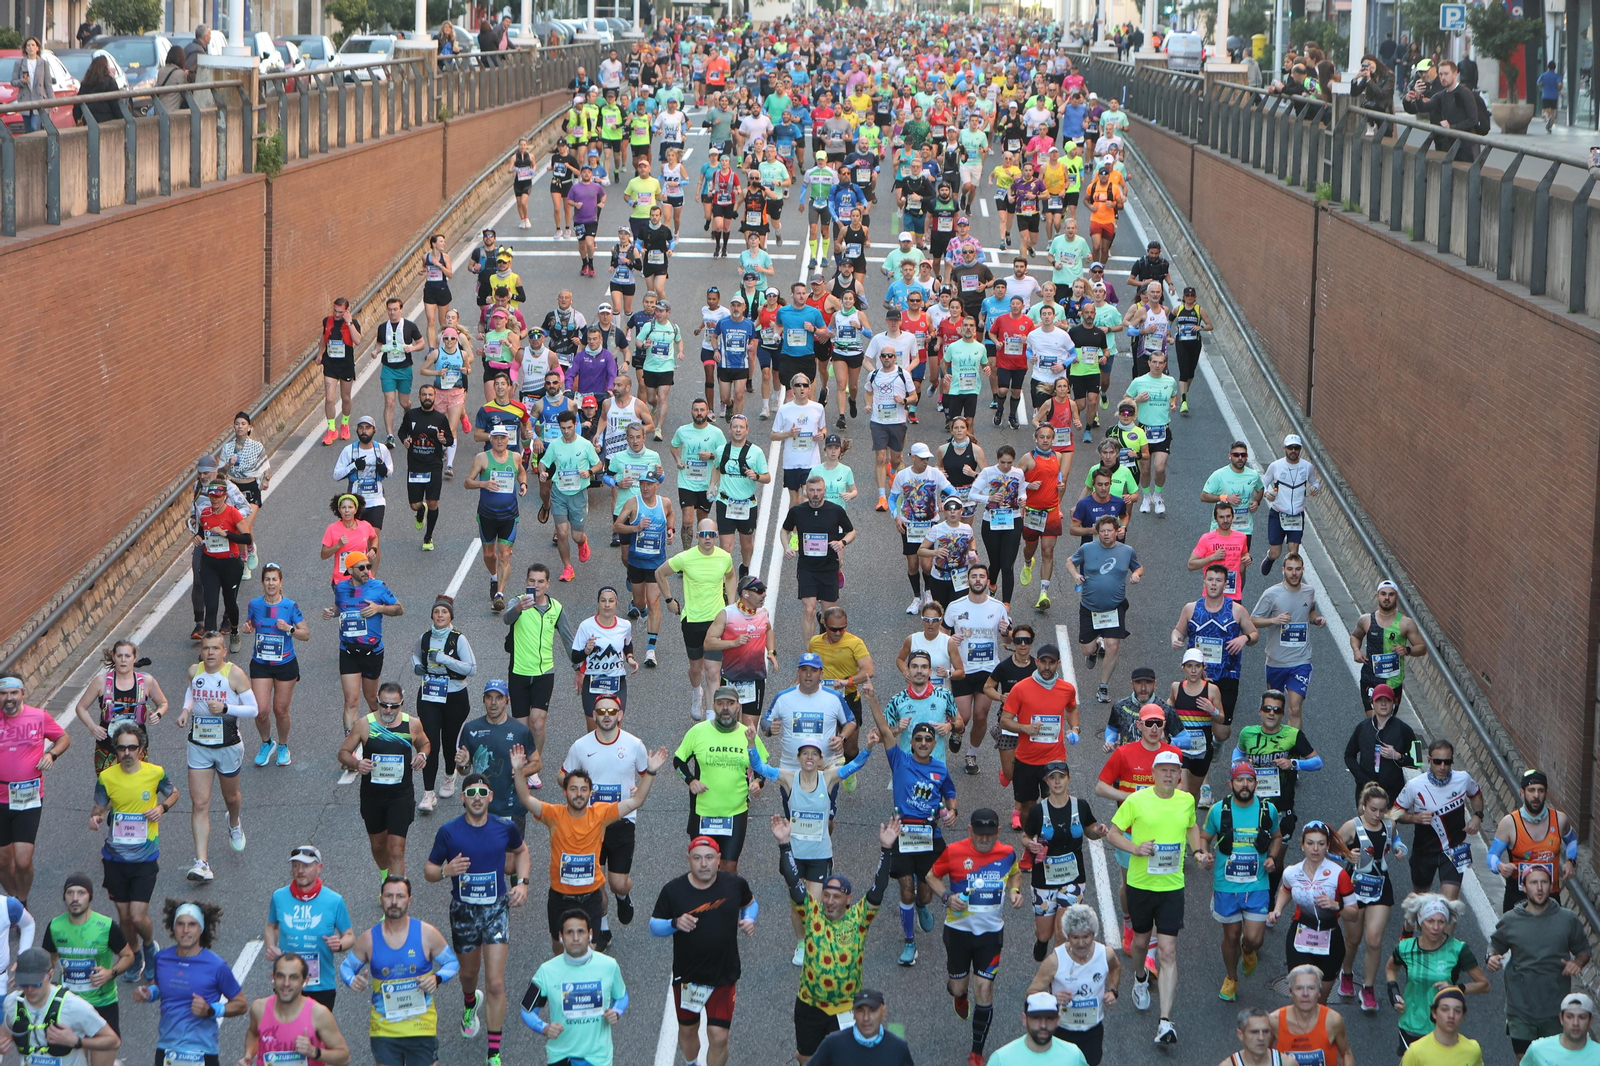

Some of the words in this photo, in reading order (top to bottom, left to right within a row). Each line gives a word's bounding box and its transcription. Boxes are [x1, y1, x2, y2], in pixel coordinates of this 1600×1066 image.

[1446, 8, 1461, 28] P
[193, 689, 227, 698] BERLIN
[1363, 875, 1381, 883] ZURICH
[293, 905, 312, 918] 21K
